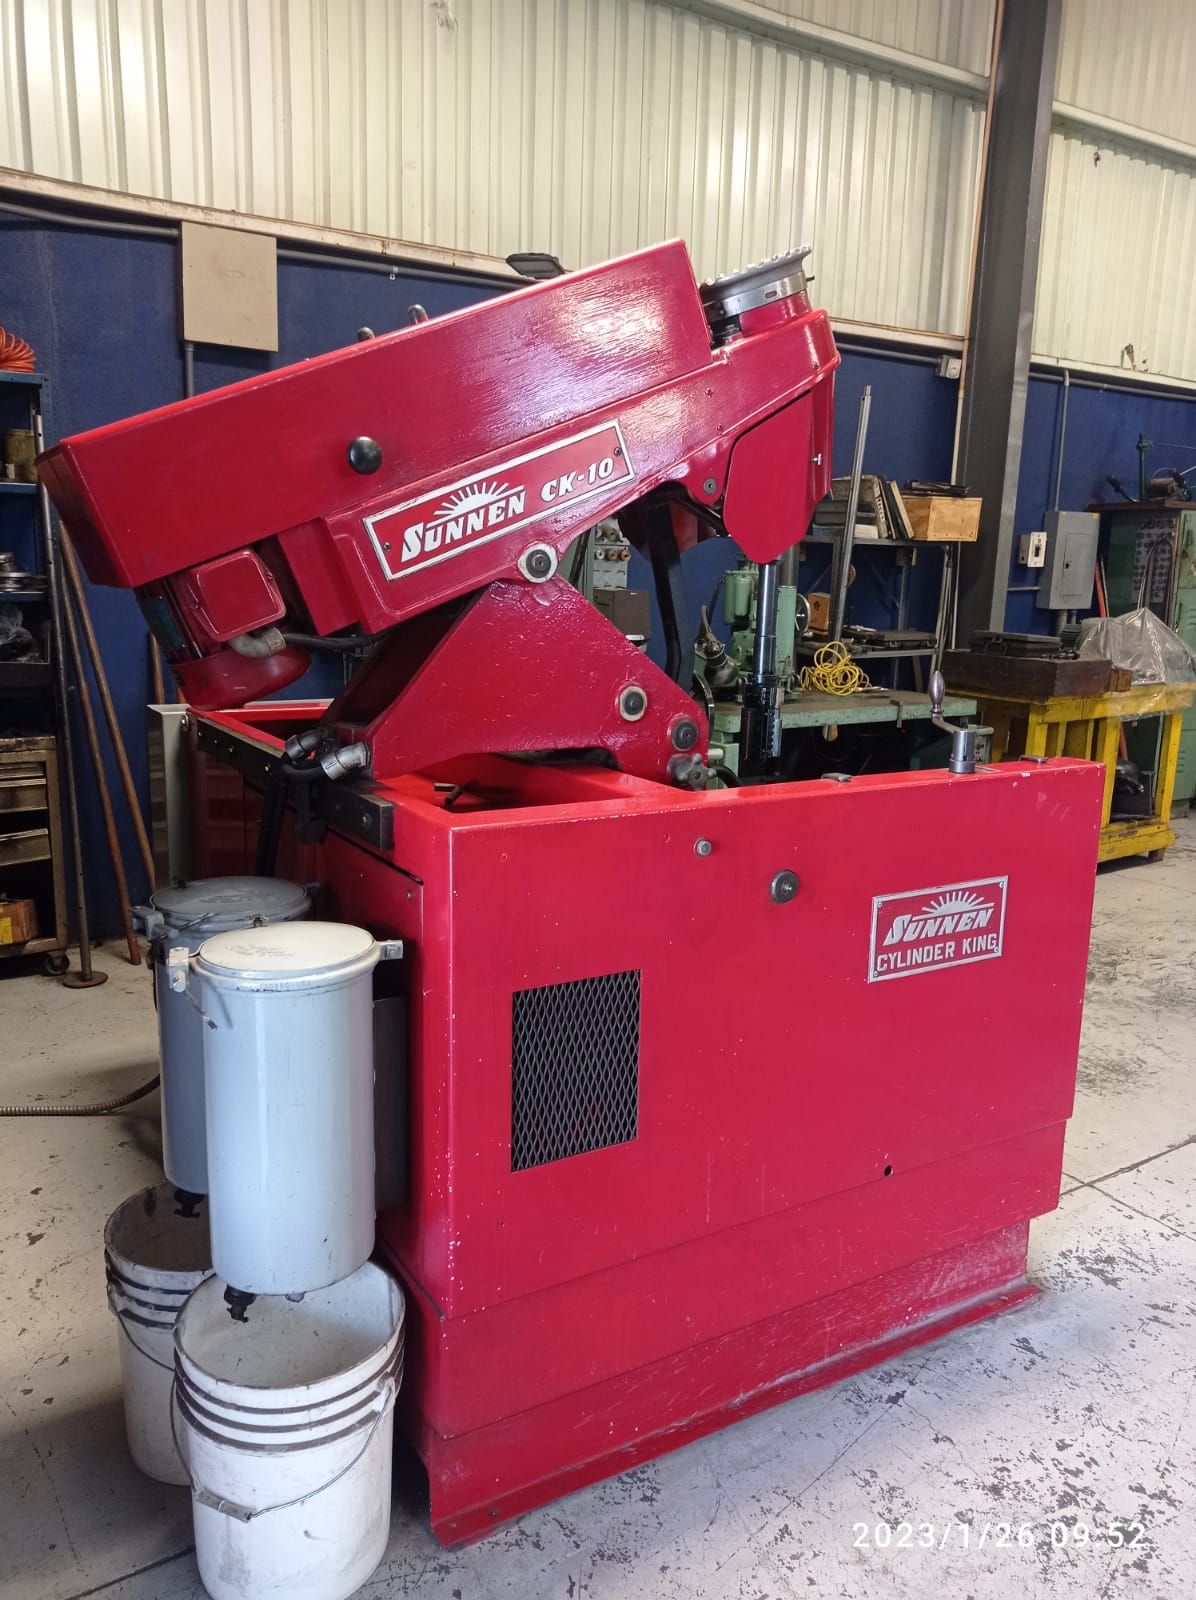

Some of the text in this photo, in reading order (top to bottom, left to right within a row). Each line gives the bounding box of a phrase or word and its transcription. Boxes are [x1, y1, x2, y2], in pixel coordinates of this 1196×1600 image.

[401, 457, 615, 563] SUNNEN CK-10
[883, 908, 995, 946] SUNNEN
[876, 933, 998, 973] CYLINDER KING
